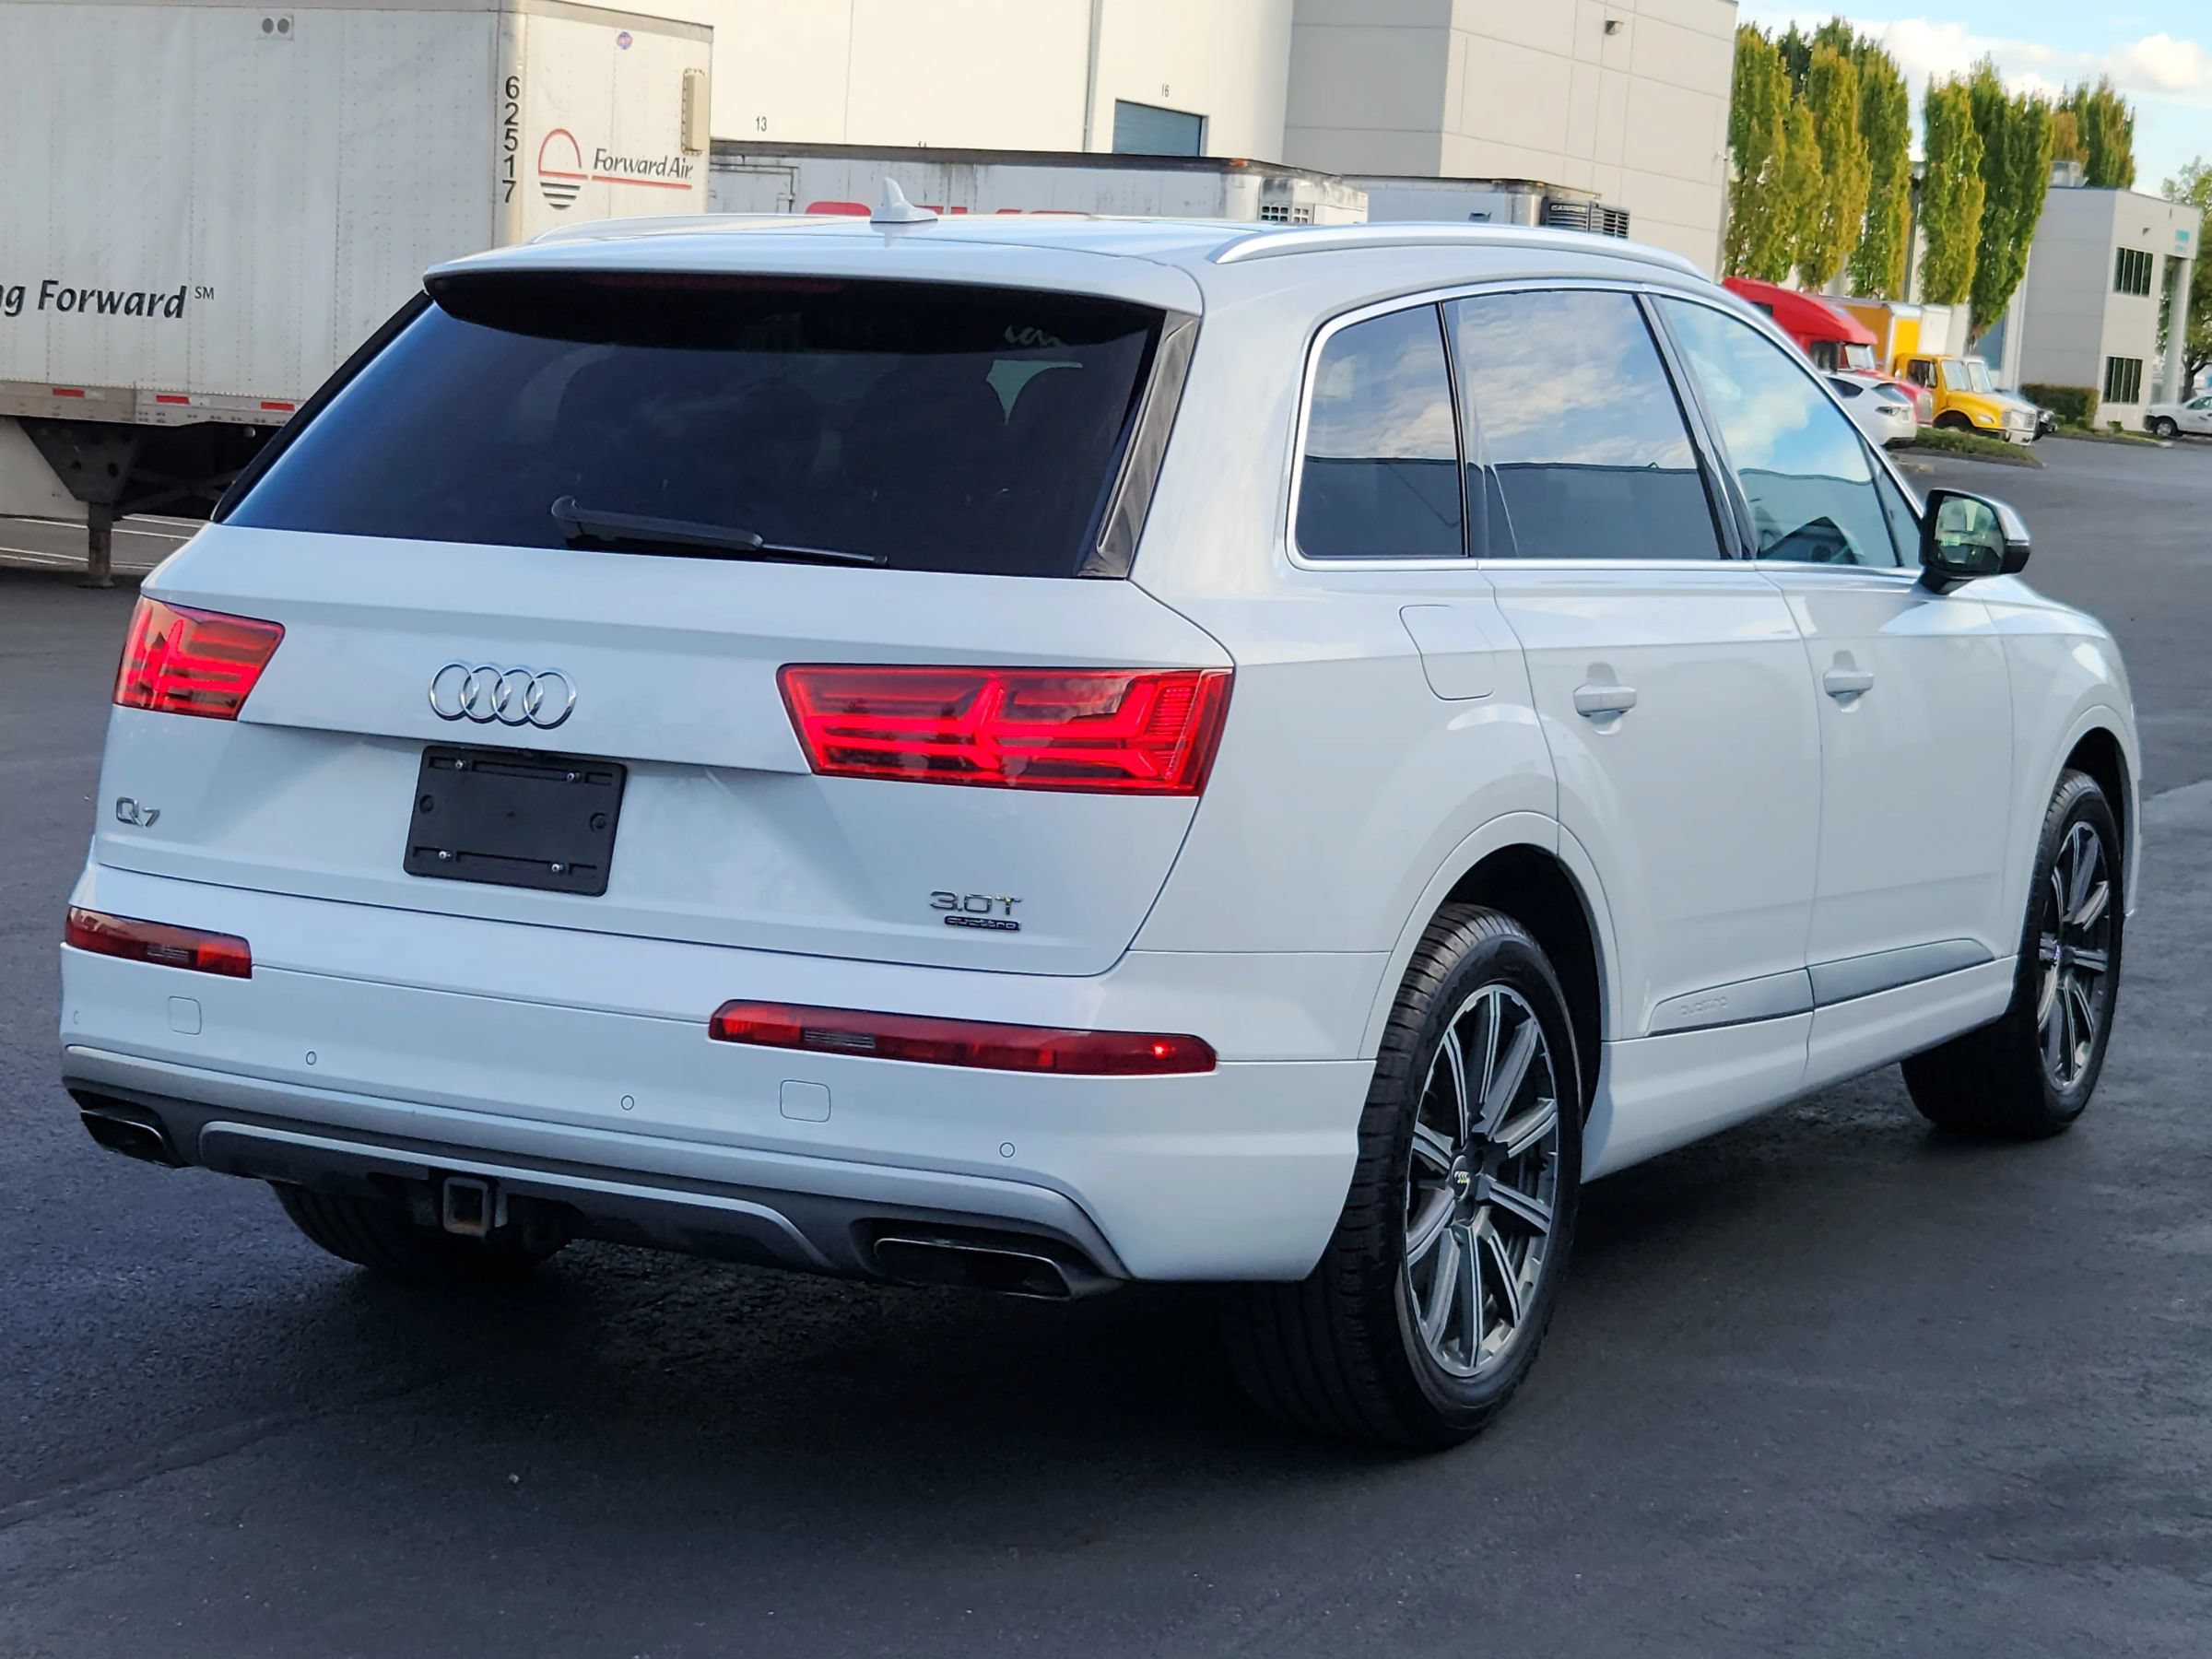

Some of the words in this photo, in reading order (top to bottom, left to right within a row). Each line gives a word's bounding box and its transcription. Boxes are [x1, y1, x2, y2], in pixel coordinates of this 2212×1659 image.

[1161, 83, 1170, 98] 16
[502, 76, 520, 204] 62517
[755, 115, 768, 133] 13
[593, 147, 668, 177] Forward
[667, 156, 694, 180] Air
[0, 284, 26, 317] g
[38, 279, 187, 319] Forward
[194, 287, 215, 300] SM
[115, 796, 161, 828] Q7
[929, 889, 1022, 916] 3.0T
